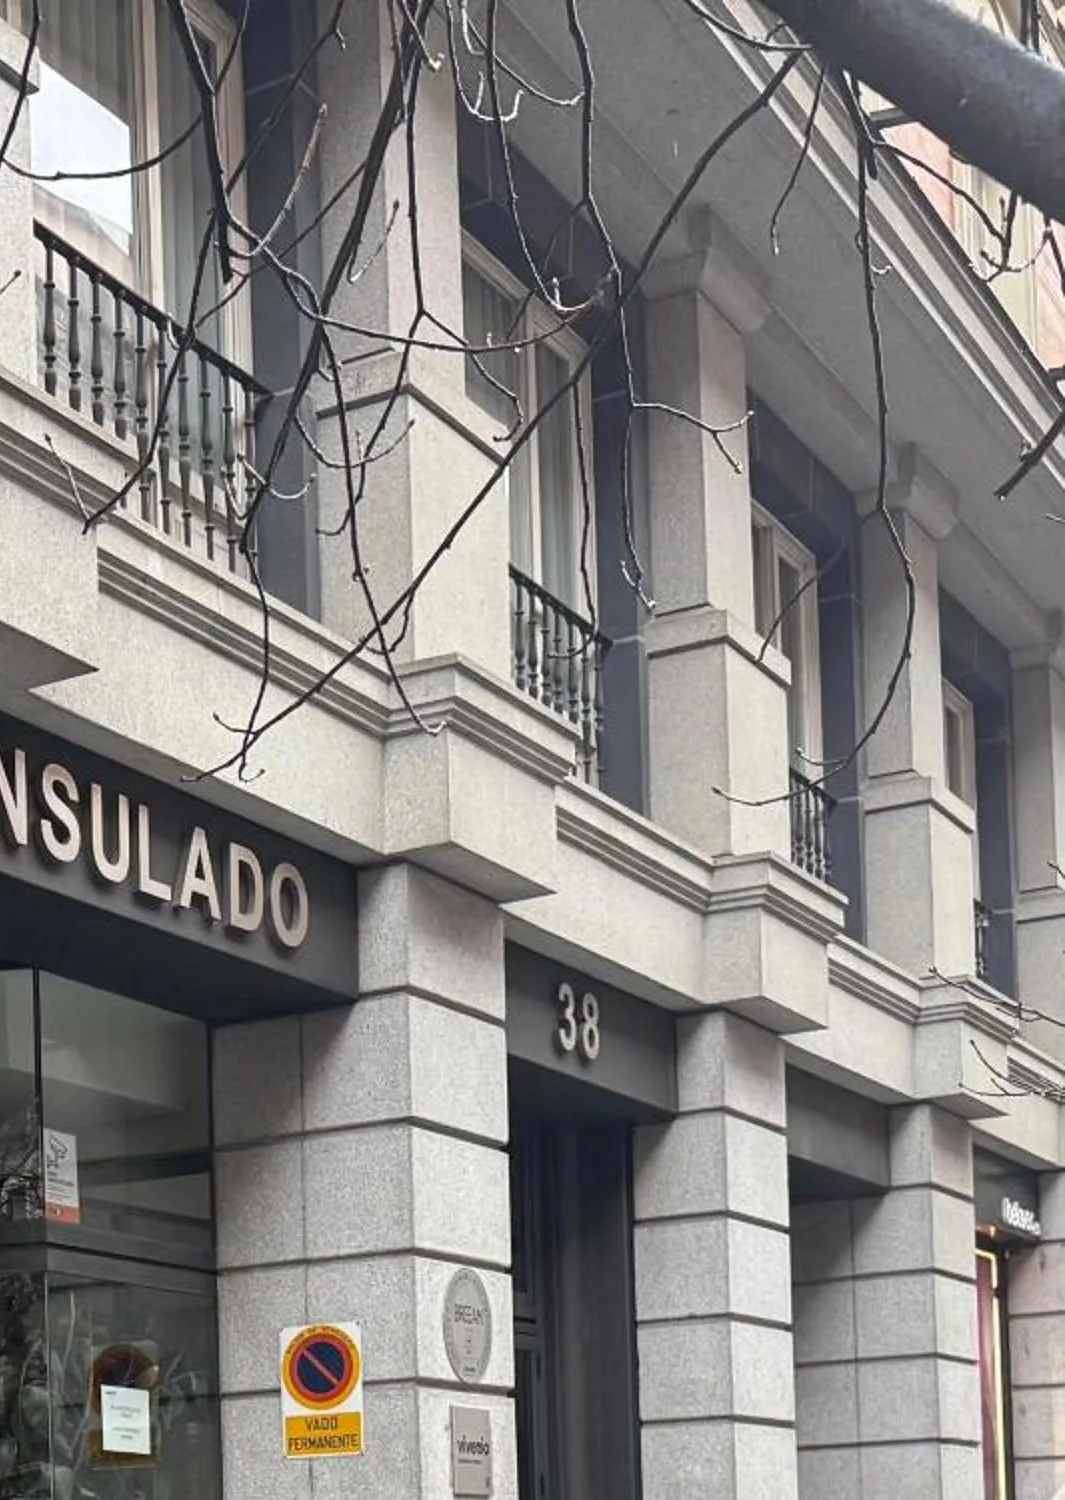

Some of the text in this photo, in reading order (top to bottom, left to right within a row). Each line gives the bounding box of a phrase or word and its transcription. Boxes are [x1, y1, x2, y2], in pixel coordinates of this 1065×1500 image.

[558, 982, 599, 1059] 38
[304, 1415, 338, 1430] VADO
[288, 1433, 359, 1452] PERMANENTE
